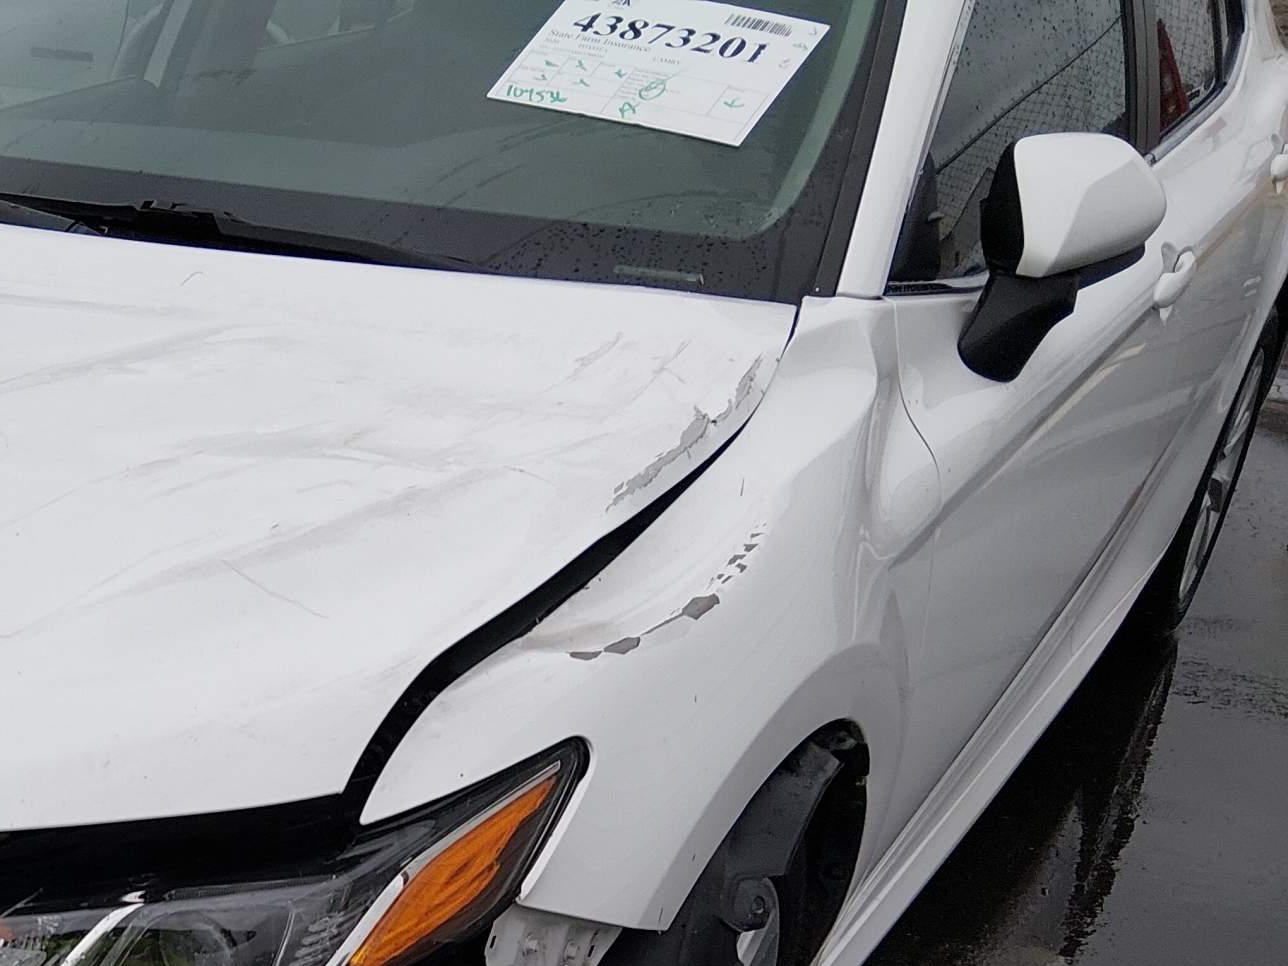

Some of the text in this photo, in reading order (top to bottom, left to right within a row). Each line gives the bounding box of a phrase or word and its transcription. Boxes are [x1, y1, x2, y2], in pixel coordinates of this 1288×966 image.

[550, 29, 574, 39] State
[575, 33, 601, 44] Farm
[602, 38, 652, 52] Insurance
[573, 12, 769, 64] 43873201
